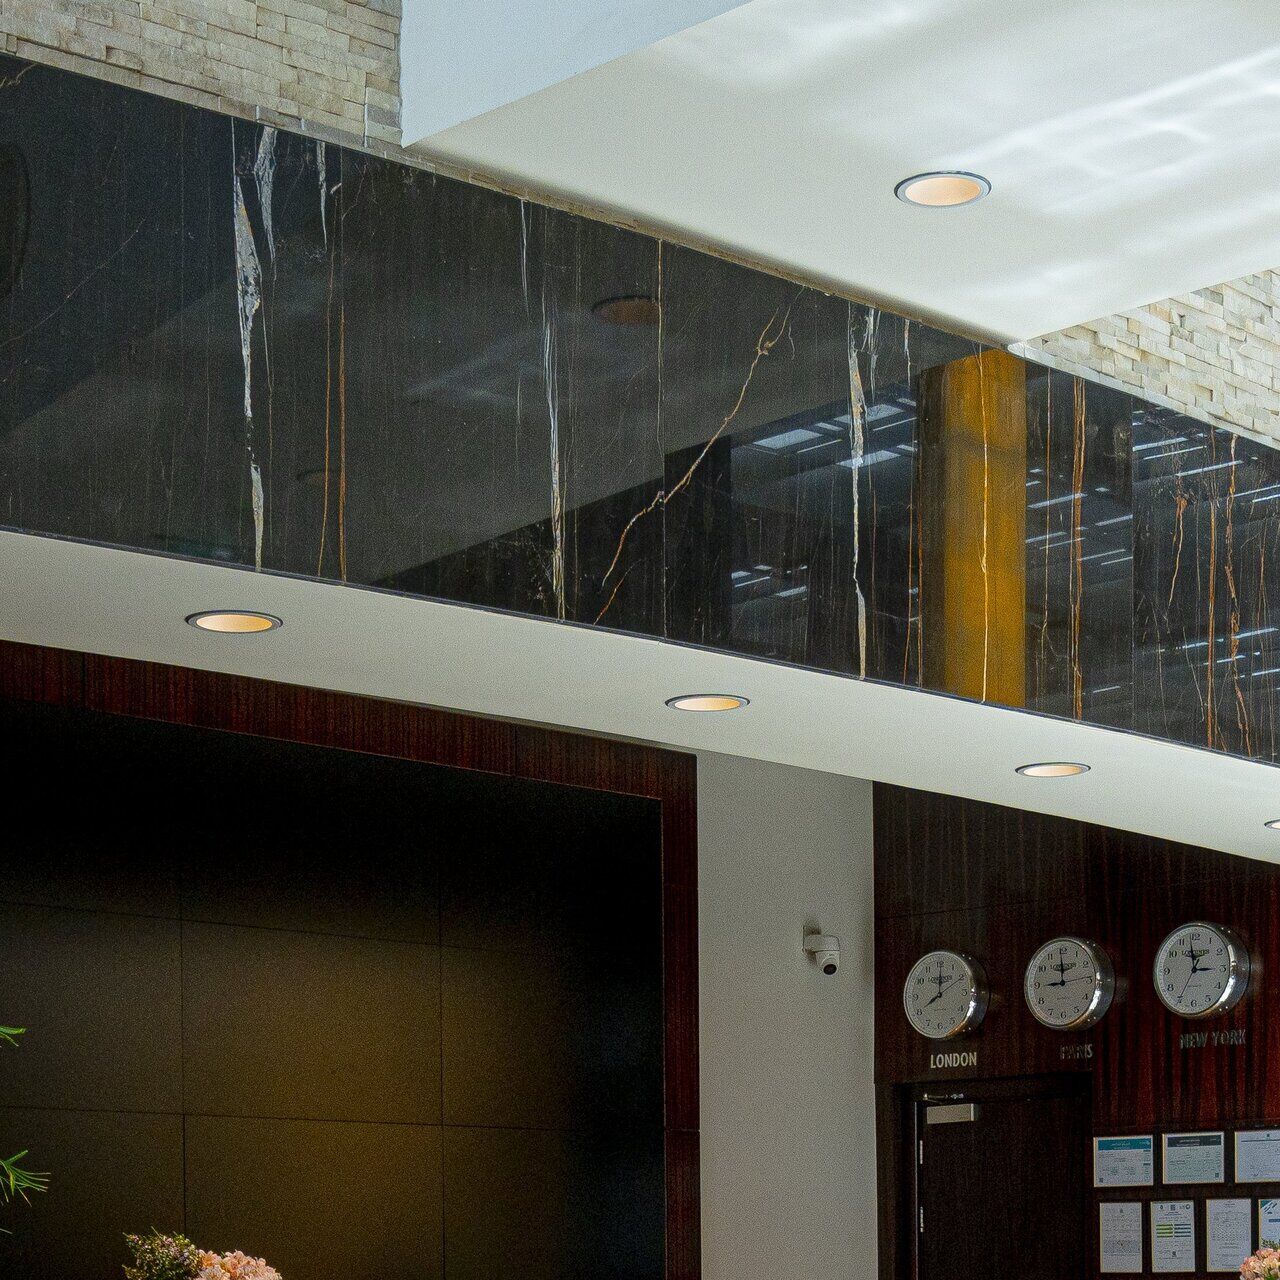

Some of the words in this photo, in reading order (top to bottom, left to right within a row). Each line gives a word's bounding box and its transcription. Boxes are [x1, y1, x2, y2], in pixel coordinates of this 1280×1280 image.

[1180, 1033, 1207, 1049] NEW
[1211, 1029, 1246, 1046] YORK
[1060, 1043, 1093, 1059] PARIS
[930, 1052, 977, 1068] LONDON
